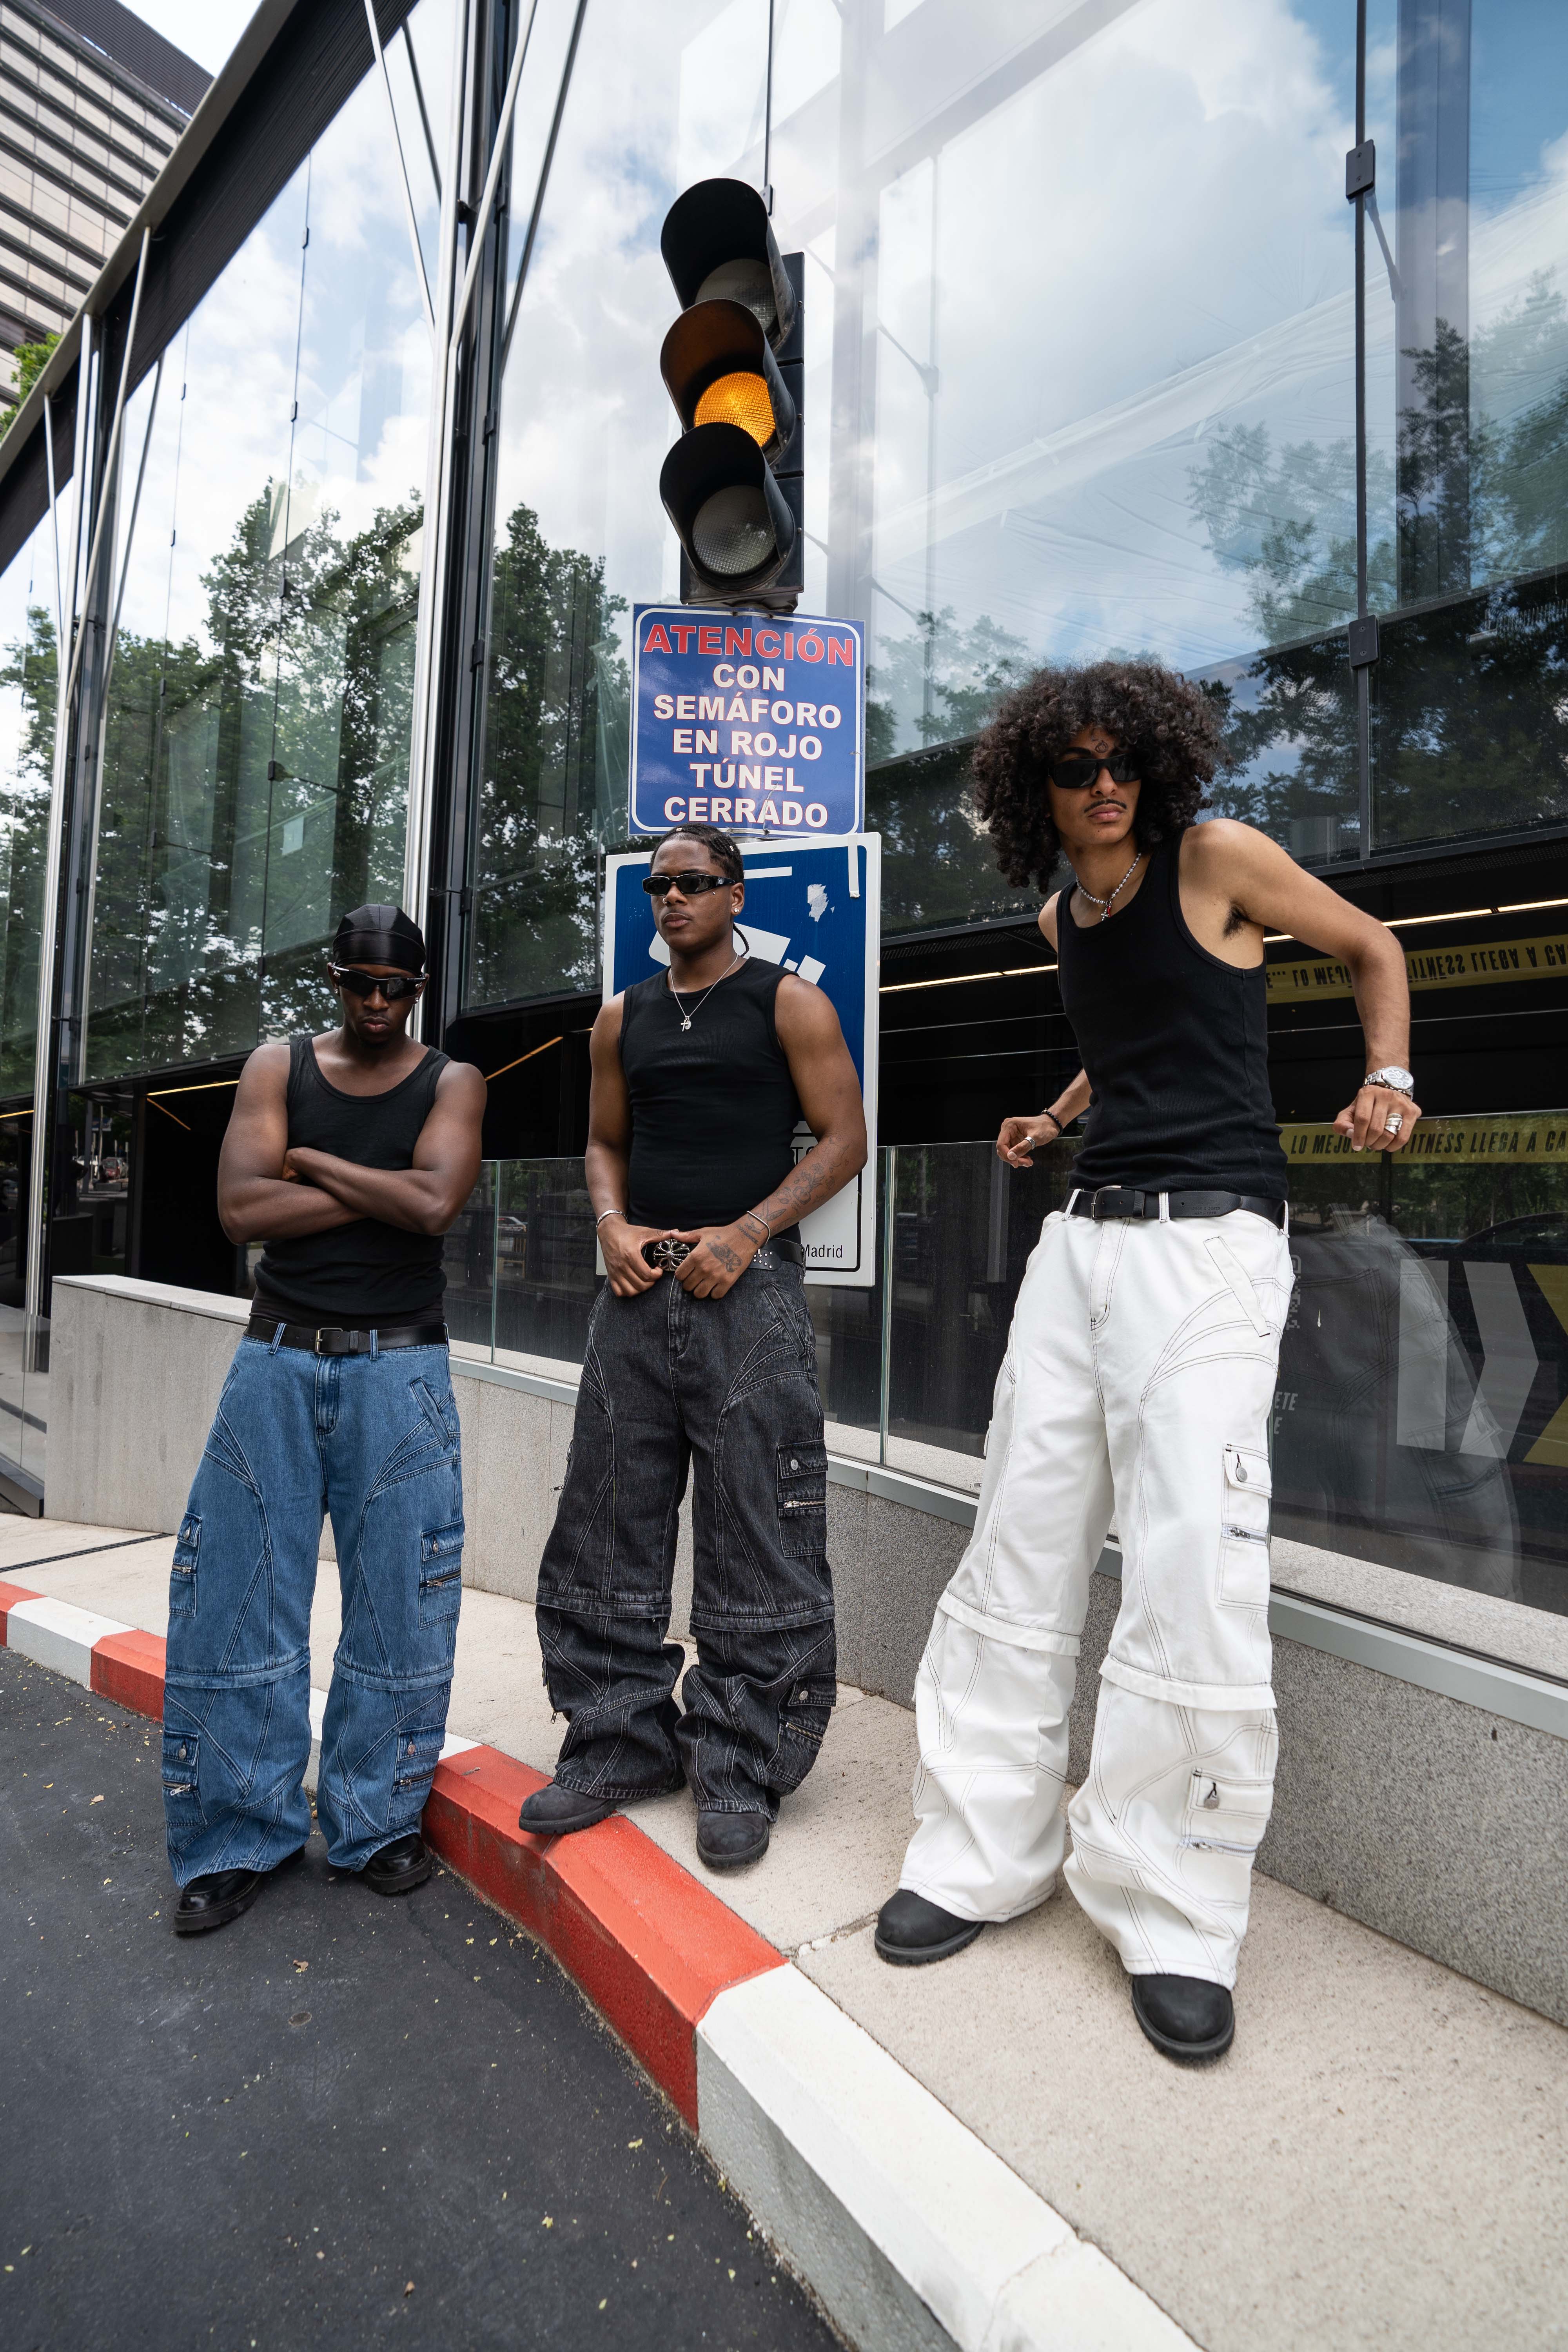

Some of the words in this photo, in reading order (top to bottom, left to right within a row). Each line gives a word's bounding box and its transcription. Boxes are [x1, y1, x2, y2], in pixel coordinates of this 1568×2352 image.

[644, 624, 854, 666] ATENCIÓN
[713, 663, 785, 691] CON
[654, 692, 841, 729] SEMÁFORO
[673, 729, 718, 755] EN
[731, 731, 822, 760] ROJO
[690, 759, 804, 793] TÚNEL
[664, 797, 828, 828] CERRADO
[1291, 1135, 1308, 1154] LO
[1312, 1134, 1358, 1154] MEJO
[1470, 1132, 1519, 1153] LLEGA
[1525, 1131, 1537, 1152] A
